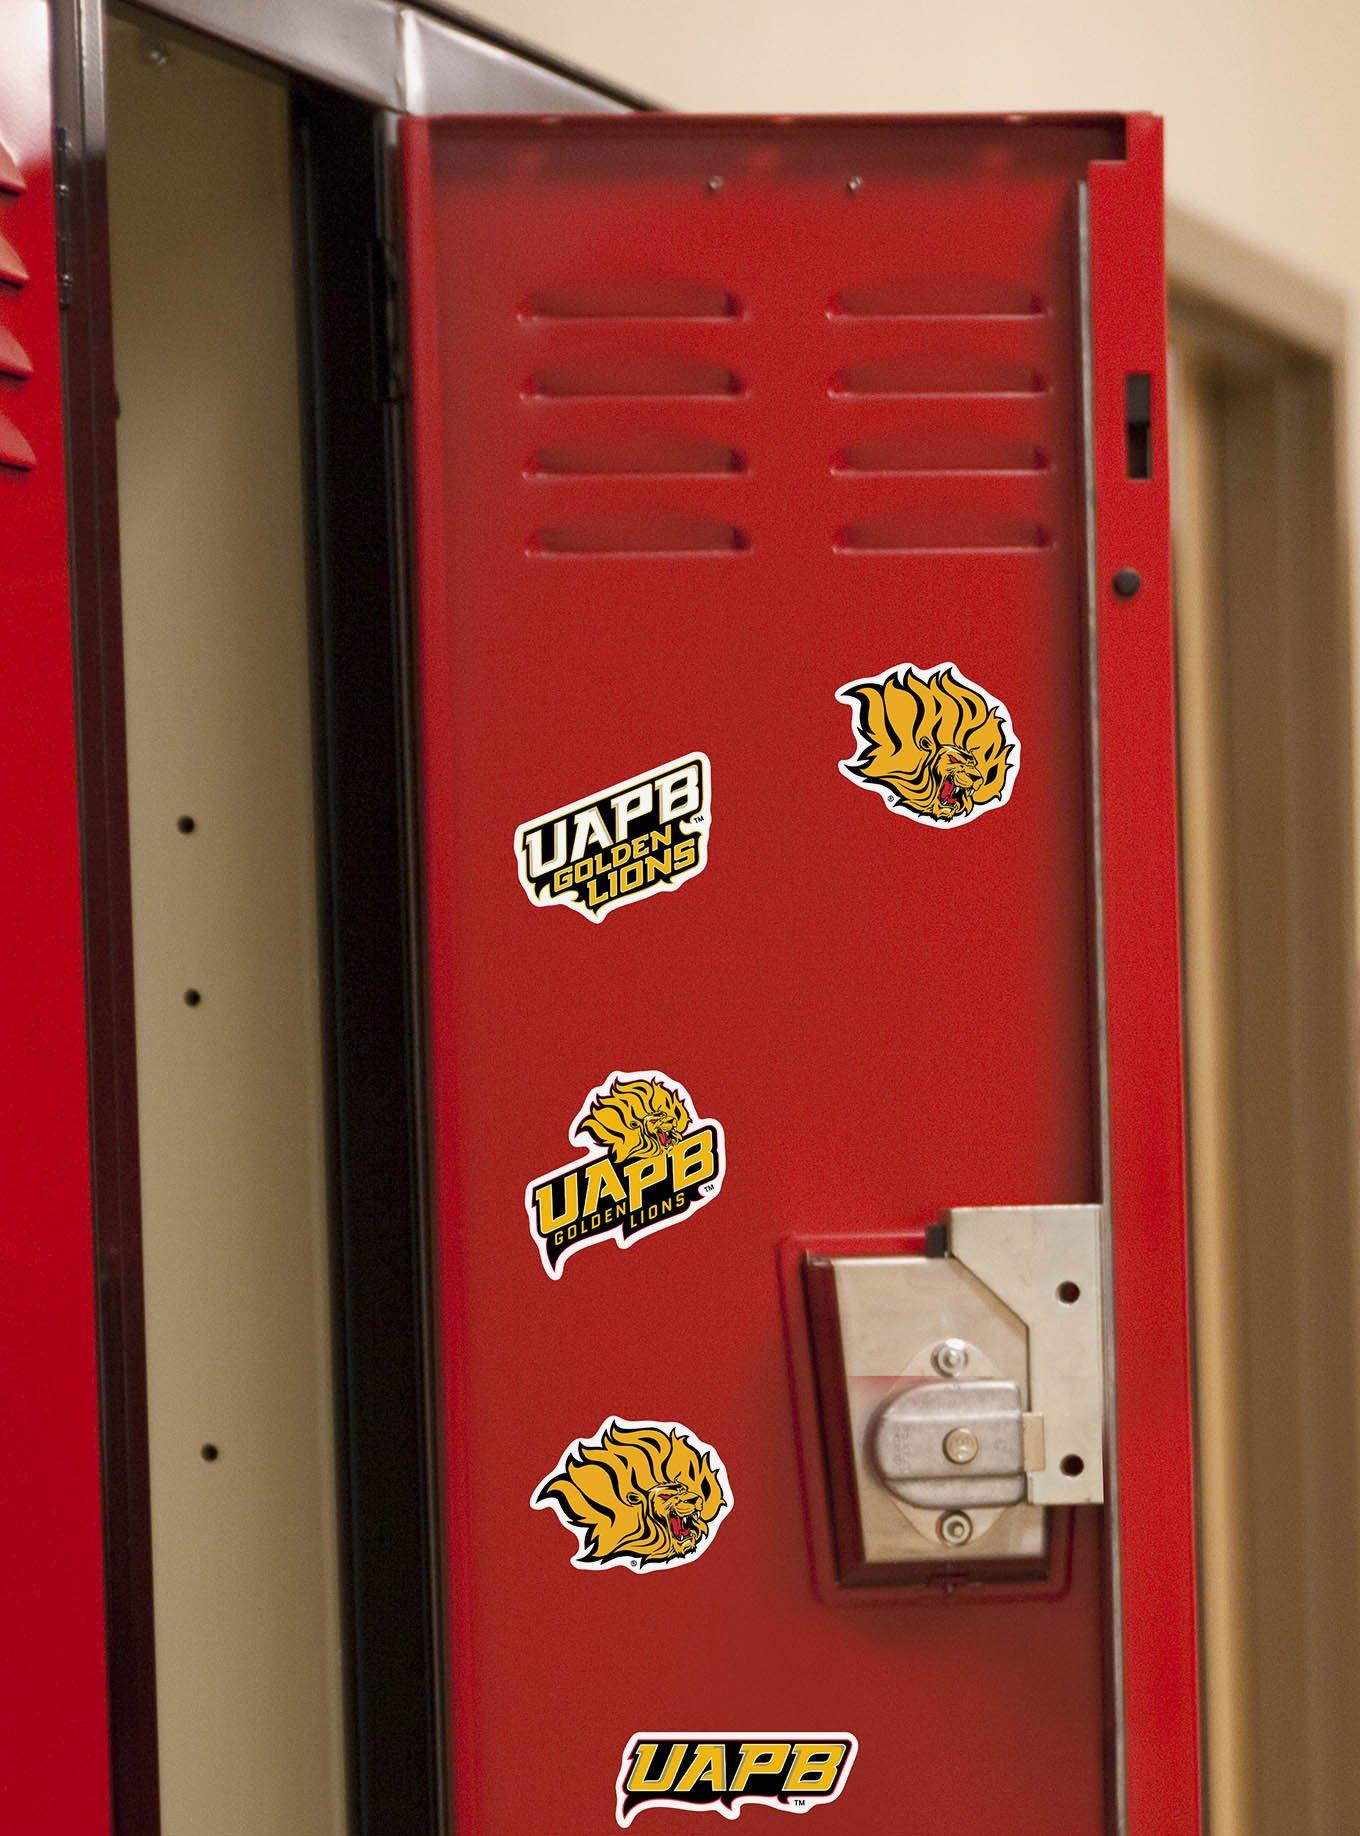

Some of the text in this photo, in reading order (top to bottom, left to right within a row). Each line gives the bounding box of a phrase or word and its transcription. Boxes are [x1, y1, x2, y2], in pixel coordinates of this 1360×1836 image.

[526, 765, 700, 878] UAPB
[694, 815, 704, 824] TM
[554, 824, 671, 893] GOLDEN
[587, 838, 695, 906] LIONS
[536, 1129, 714, 1234] UAPB
[704, 1184, 715, 1193] TM
[555, 1192, 685, 1245] GOLDEN LIONS
[627, 1743, 846, 1791] UAPB
